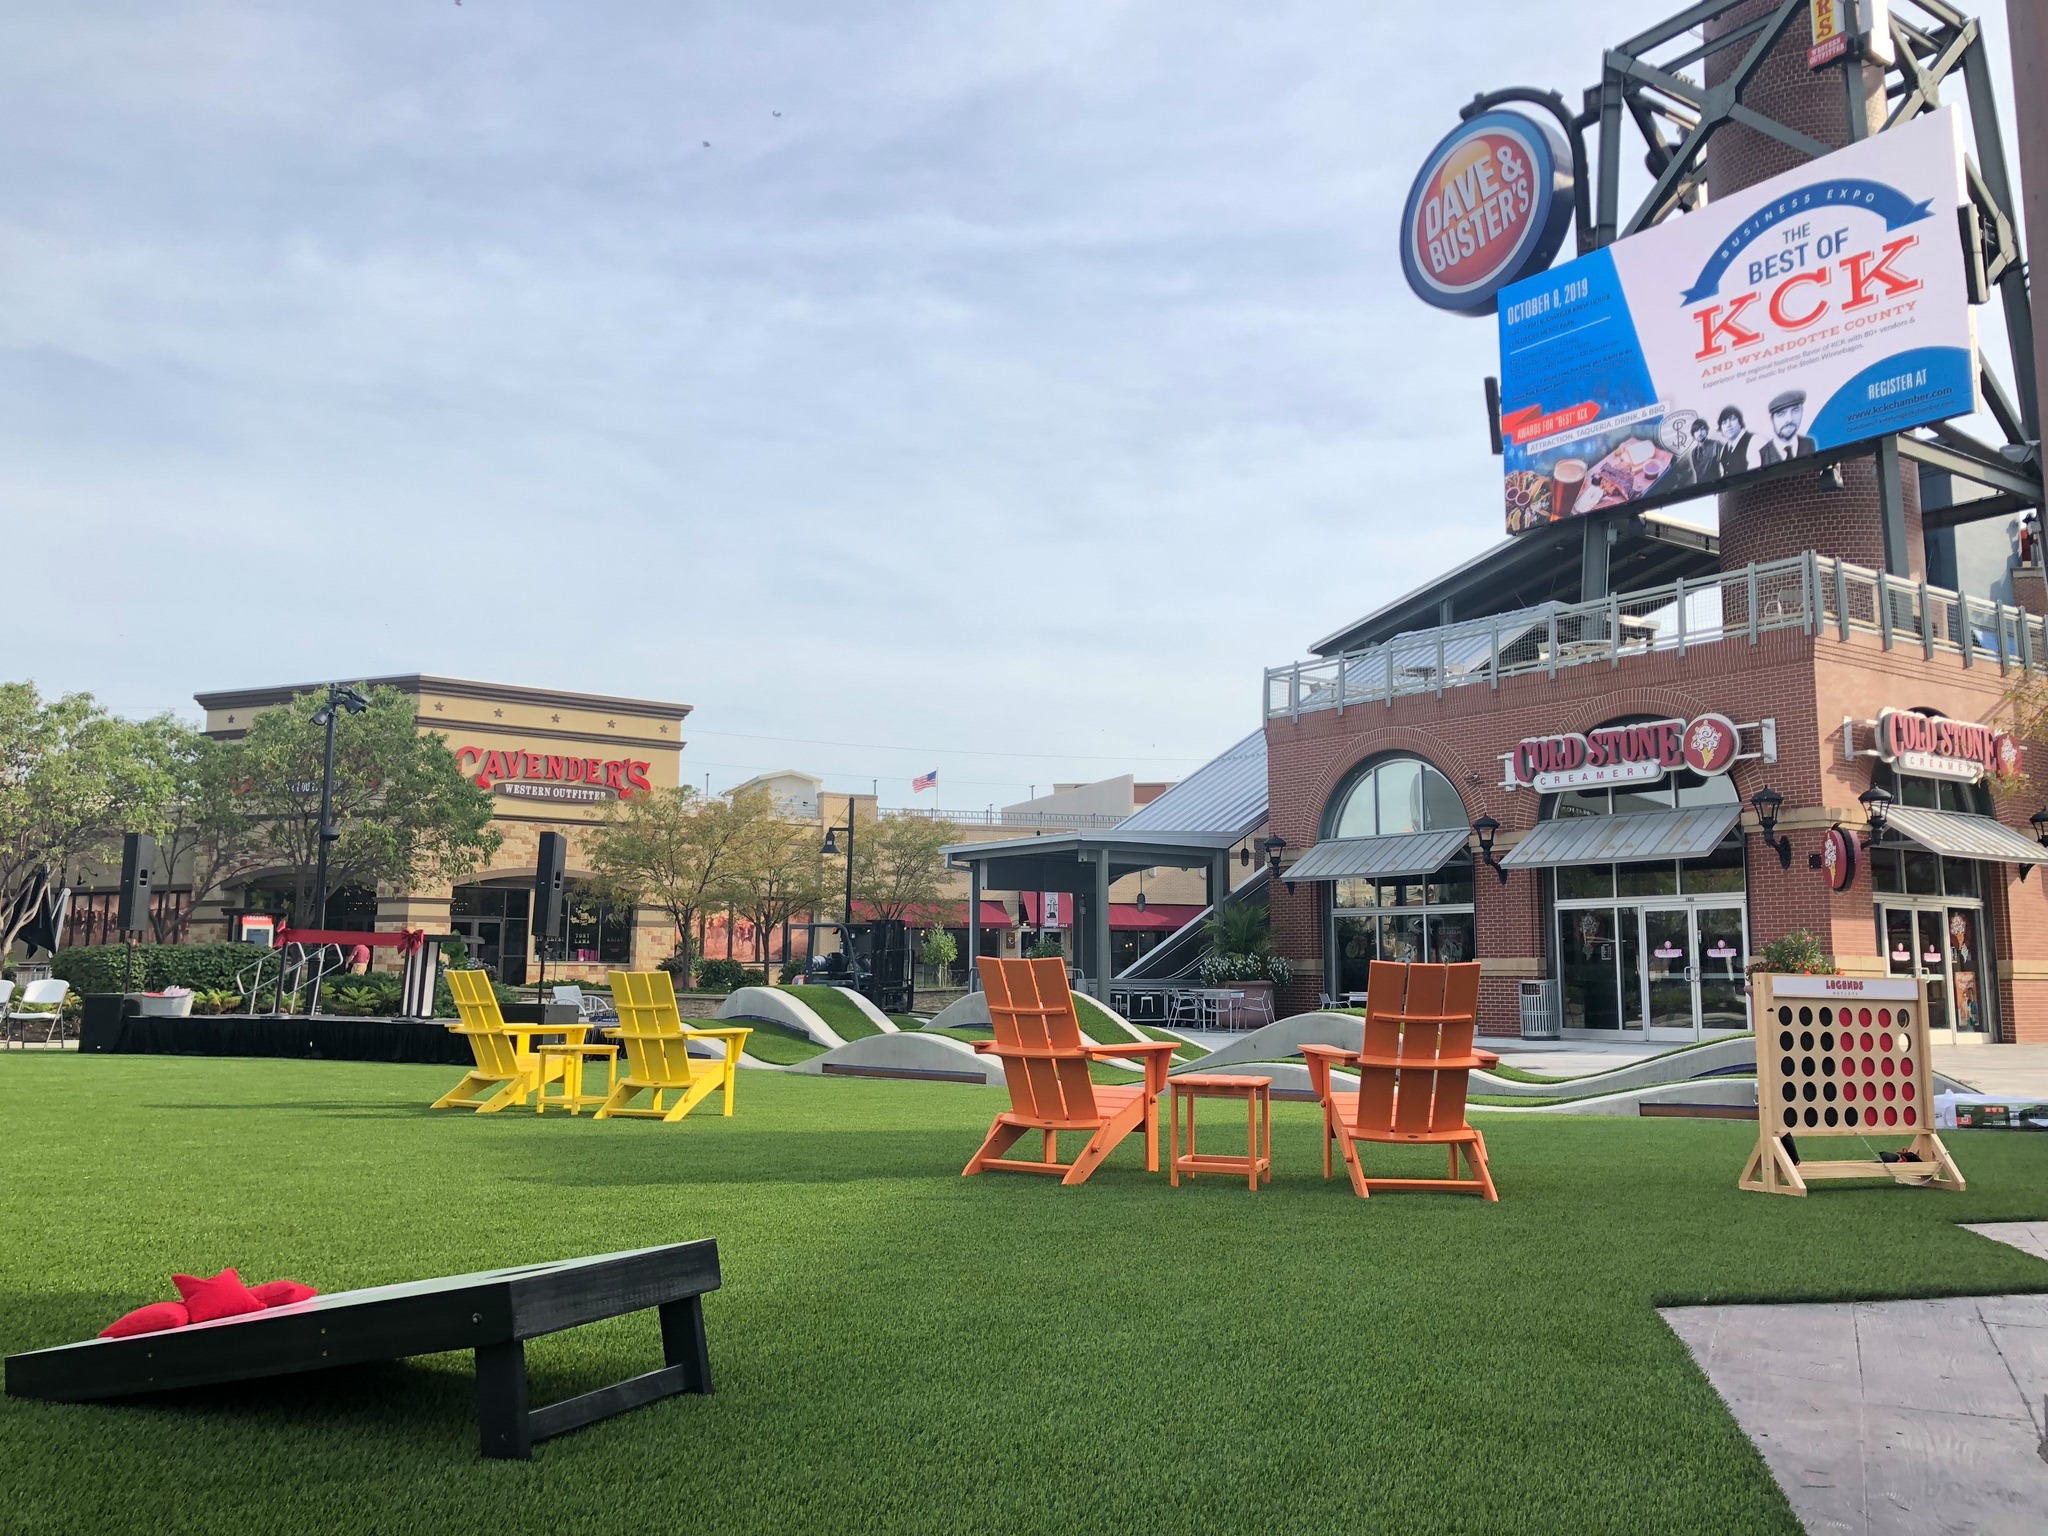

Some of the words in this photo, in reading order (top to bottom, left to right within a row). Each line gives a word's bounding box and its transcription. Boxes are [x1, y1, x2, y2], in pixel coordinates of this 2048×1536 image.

[1426, 154, 1499, 243] DAVE
[1497, 145, 1525, 182] &
[1429, 177, 1529, 274] BUSTER'S
[1721, 193, 1810, 260] BUSINESS
[1826, 188, 1875, 203] EXPO
[1782, 221, 1811, 244] THE
[1749, 243, 1809, 285] BEST
[1817, 226, 1849, 259] OF
[1507, 292, 1550, 326] OCTOBER
[1553, 288, 1562, 309] 8,
[1564, 277, 1588, 304] 2019
[1693, 234, 1923, 362] KCK
[1701, 361, 1734, 378] AND
[1737, 325, 1840, 366] WYANDOTTE
[1844, 301, 1917, 331] COUNTY
[1703, 374, 1735, 389] Experience
[1736, 370, 1747, 378] the
[1748, 362, 1773, 375] regional
[1774, 353, 1801, 366] business
[1831, 339, 1846, 349] KCK
[1848, 333, 1863, 343] with
[1880, 319, 1908, 333] vendors
[1759, 370, 1776, 380] music
[1787, 362, 1798, 371] the
[1868, 373, 1913, 400] REGISTER
[1916, 369, 1927, 387] AT
[1517, 425, 1541, 440] AWARDS
[1542, 421, 1554, 431] FOR
[1577, 407, 1589, 421] KCK
[1649, 404, 1666, 415] BBQ
[1847, 387, 1953, 421] www.kckchamber.com
[1513, 736, 1584, 783] COLD
[1587, 722, 1685, 768] STONE
[1889, 713, 1938, 757] COLD
[1940, 721, 1998, 772] STONE
[456, 745, 652, 800] CAVENDER'S
[505, 783, 551, 797] WESTERN
[1540, 765, 1649, 786] CREAMERY
[1826, 979, 1864, 991] LEGENDS
